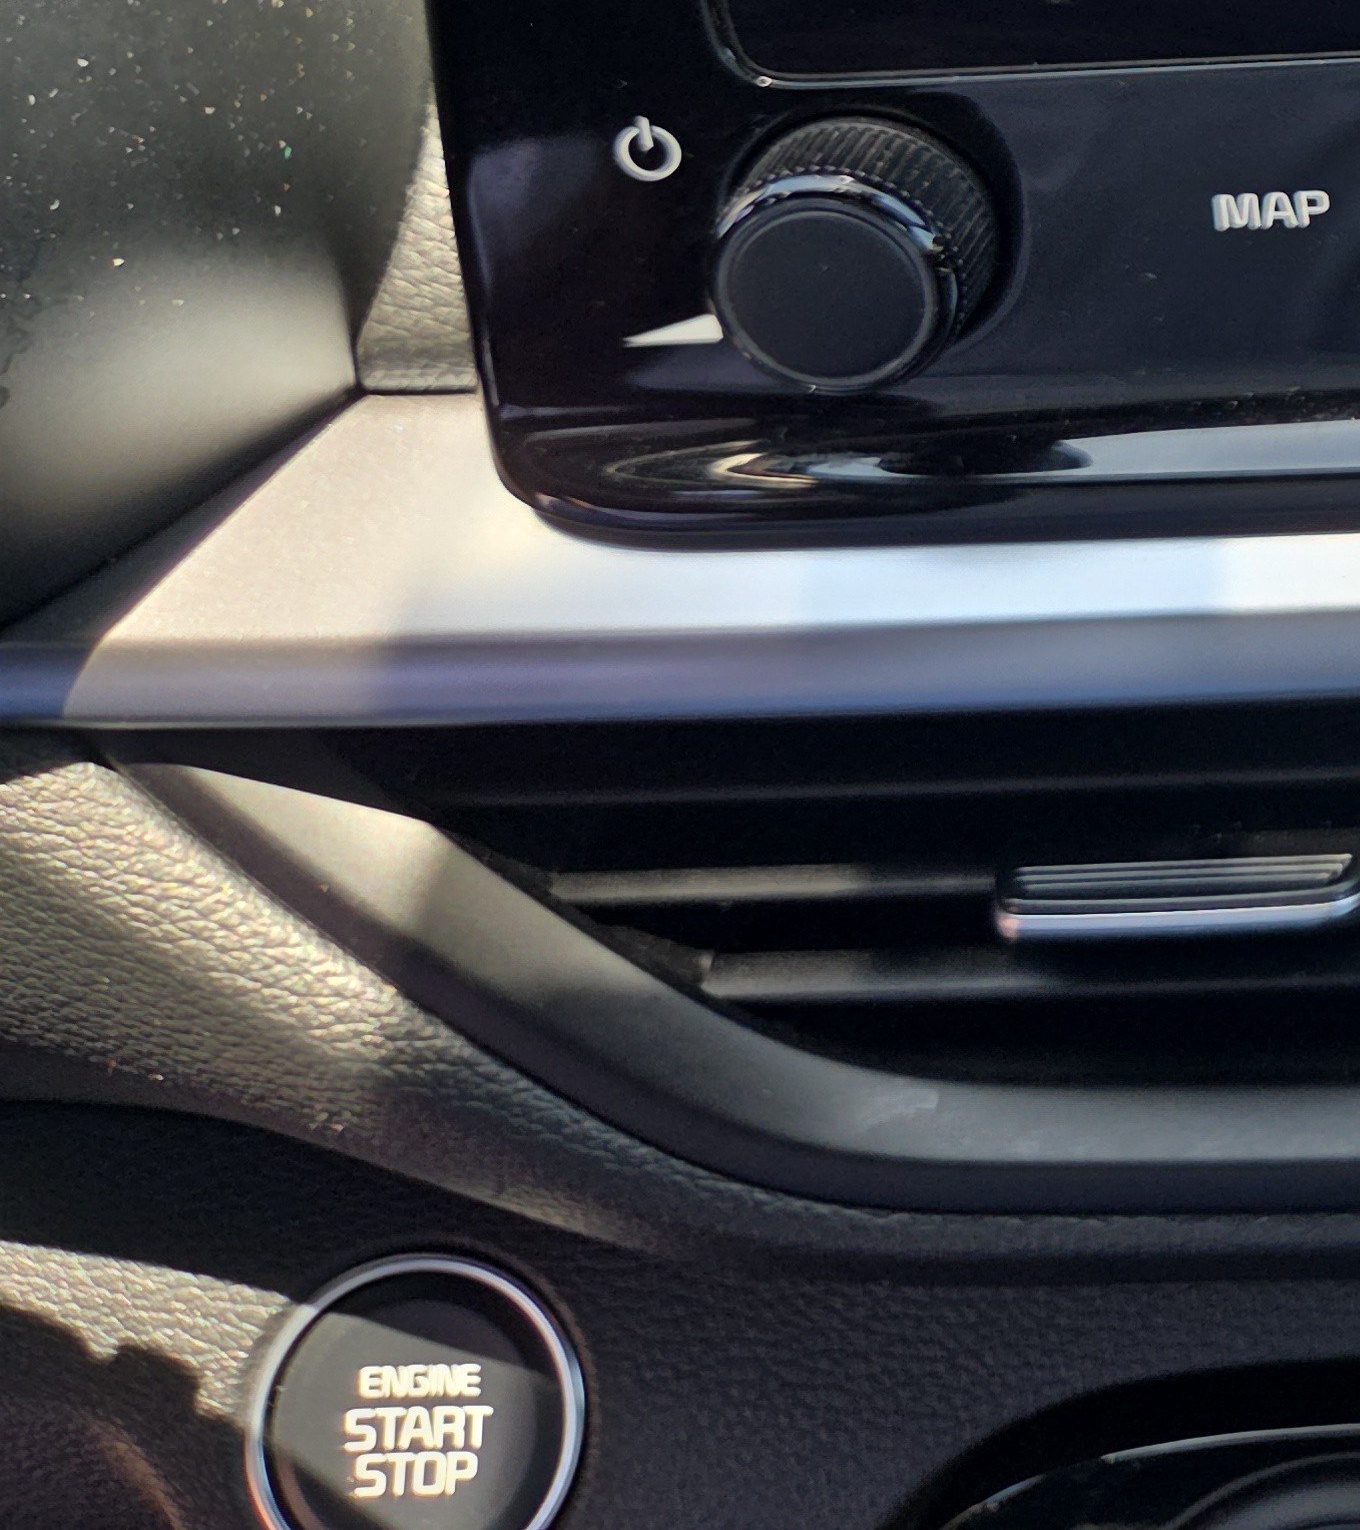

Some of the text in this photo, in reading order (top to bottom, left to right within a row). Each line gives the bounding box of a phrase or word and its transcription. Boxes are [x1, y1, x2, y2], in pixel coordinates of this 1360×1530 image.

[1211, 188, 1331, 233] MAP
[357, 1363, 483, 1399] ENGINE
[343, 1405, 495, 1452] START
[351, 1450, 479, 1499] STOP
